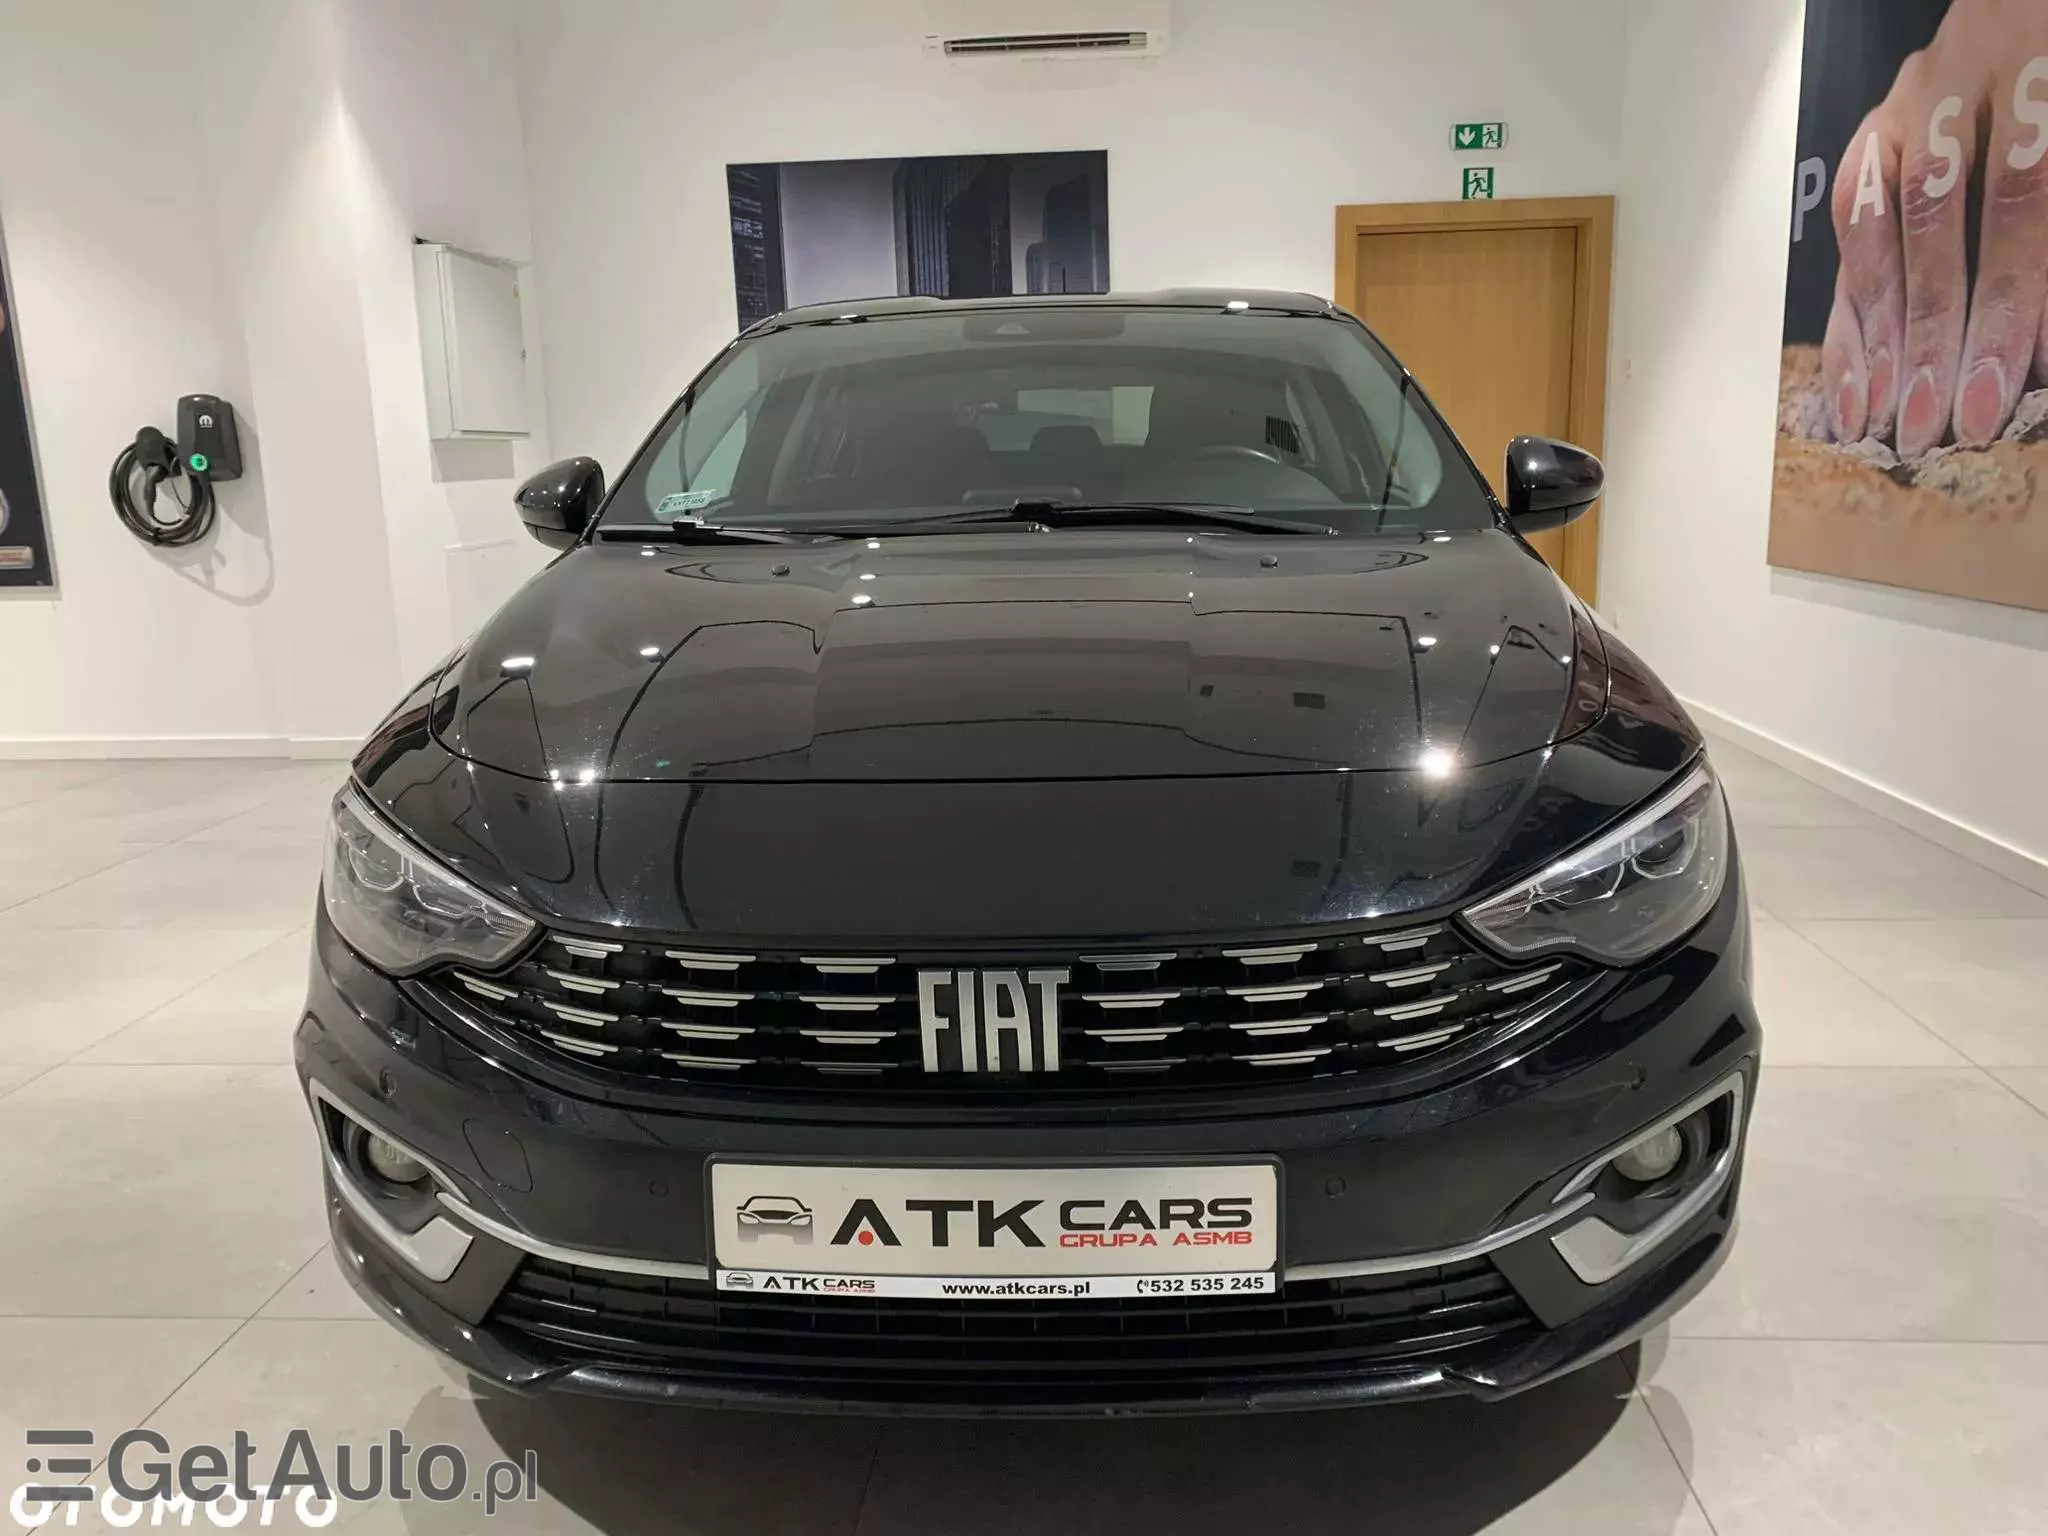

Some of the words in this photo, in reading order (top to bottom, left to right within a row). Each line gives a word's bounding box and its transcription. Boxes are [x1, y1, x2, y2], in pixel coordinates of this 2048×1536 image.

[918, 969, 1070, 1073] FIAT
[830, 1198, 1046, 1248] ATK
[1059, 1197, 1253, 1231] CARS
[1059, 1233, 1158, 1248] GRUPA
[1172, 1231, 1253, 1246] ASMB
[763, 1276, 820, 1291] ATK
[823, 1279, 875, 1289] CARS
[942, 1281, 1091, 1297] www.atkcars.pl
[1150, 1279, 1185, 1293] 532
[1190, 1278, 1225, 1292] 535
[1230, 1276, 1265, 1290] 245
